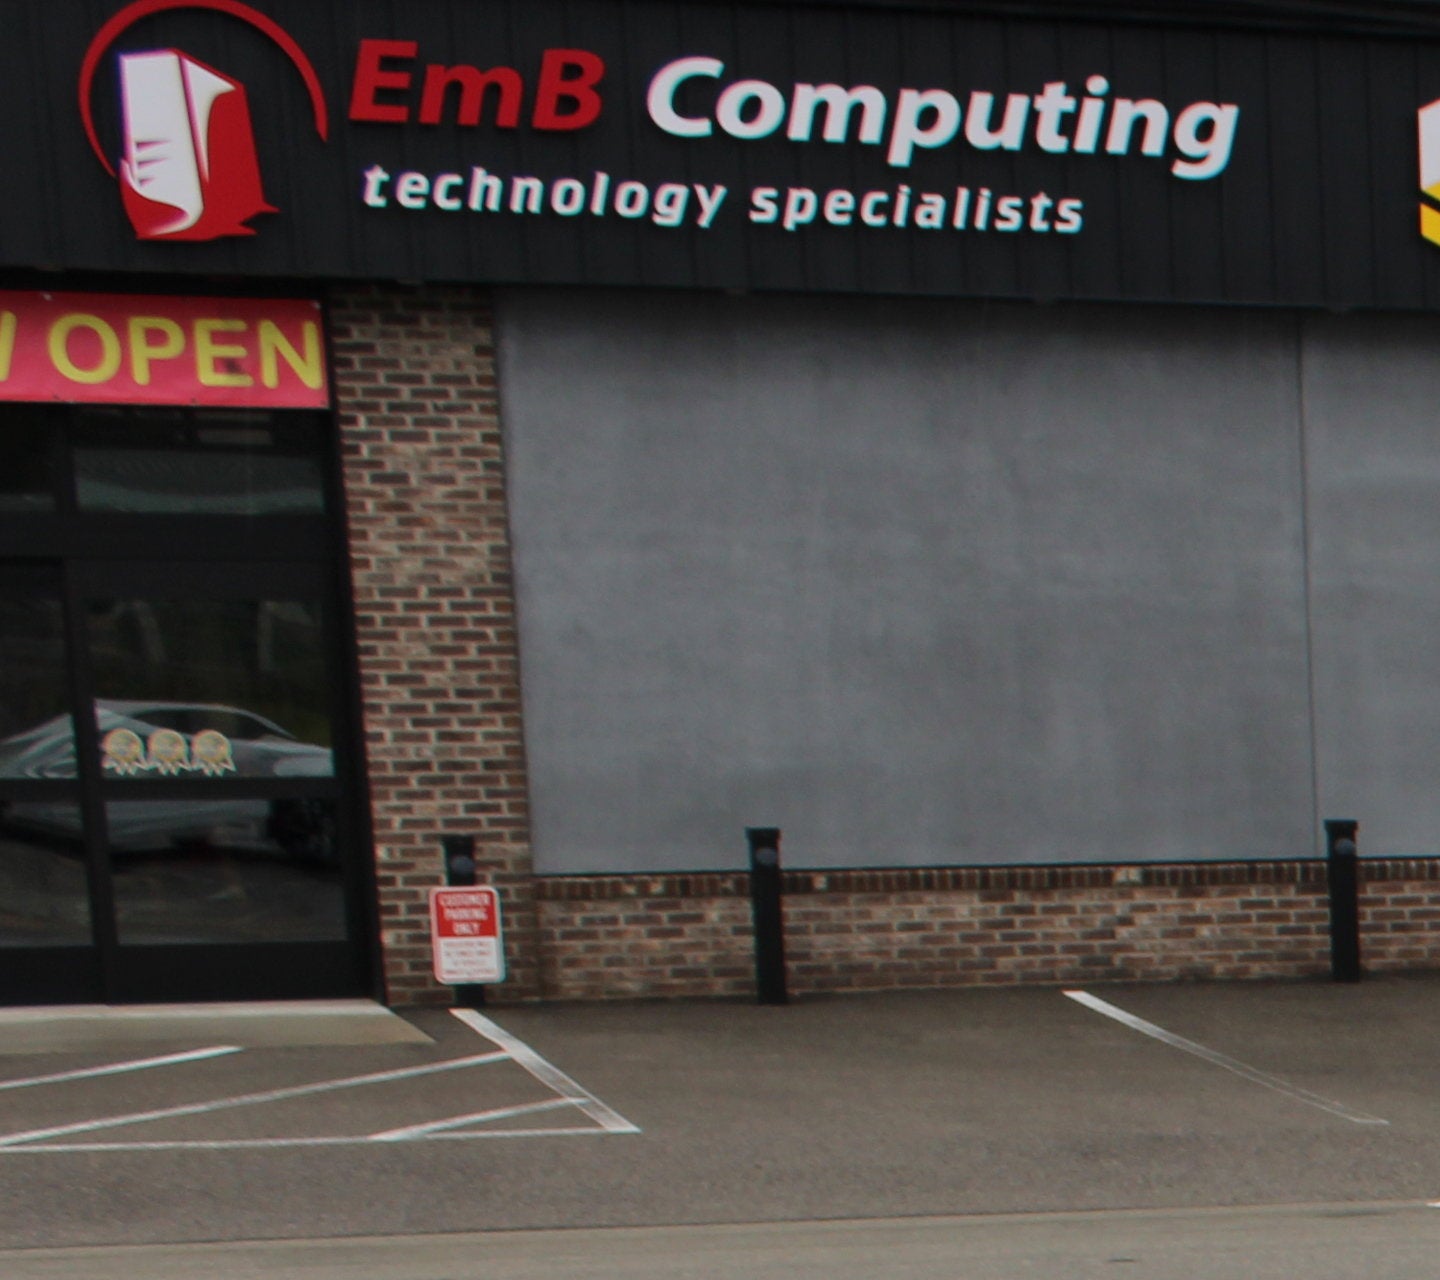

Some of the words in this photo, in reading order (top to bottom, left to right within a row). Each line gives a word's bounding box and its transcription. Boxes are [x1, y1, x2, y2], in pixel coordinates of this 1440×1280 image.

[347, 39, 606, 132] EmB
[646, 57, 1240, 178] Computing
[363, 165, 727, 228] technology
[749, 184, 1084, 234] specialists
[48, 313, 323, 389] OPEN
